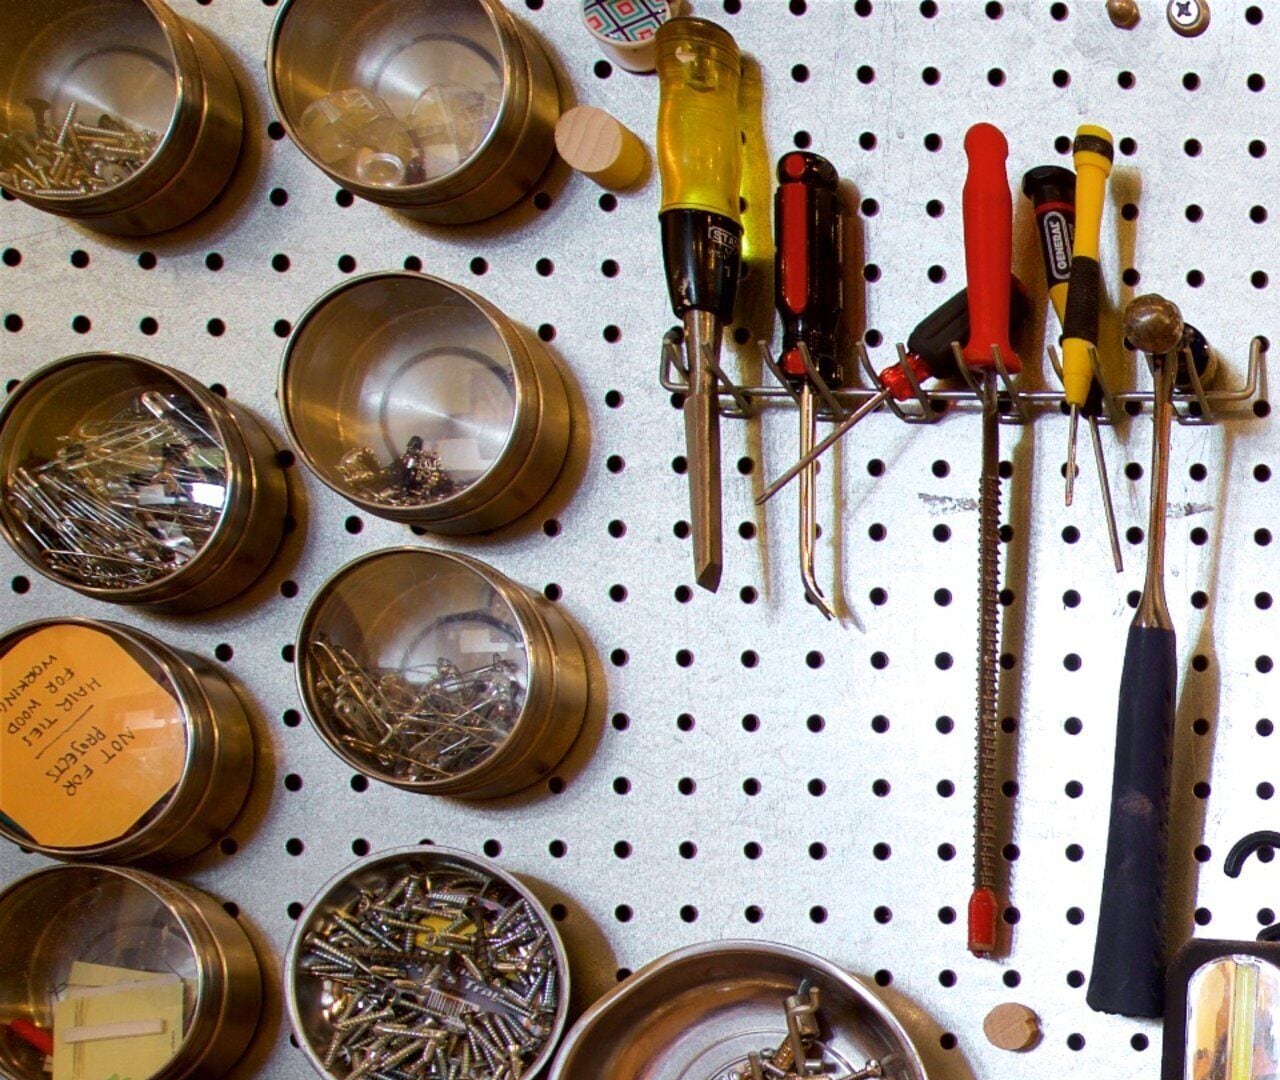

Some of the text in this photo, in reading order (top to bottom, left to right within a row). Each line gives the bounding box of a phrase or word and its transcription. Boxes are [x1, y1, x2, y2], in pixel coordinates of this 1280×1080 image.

[1048, 220, 1068, 270] GENERAL
[7, 667, 75, 734] FOR WOOD
[22, 677, 102, 747] HAIR TIES
[45, 726, 107, 783] PROJECTS
[62, 727, 136, 796] NOT FOR
